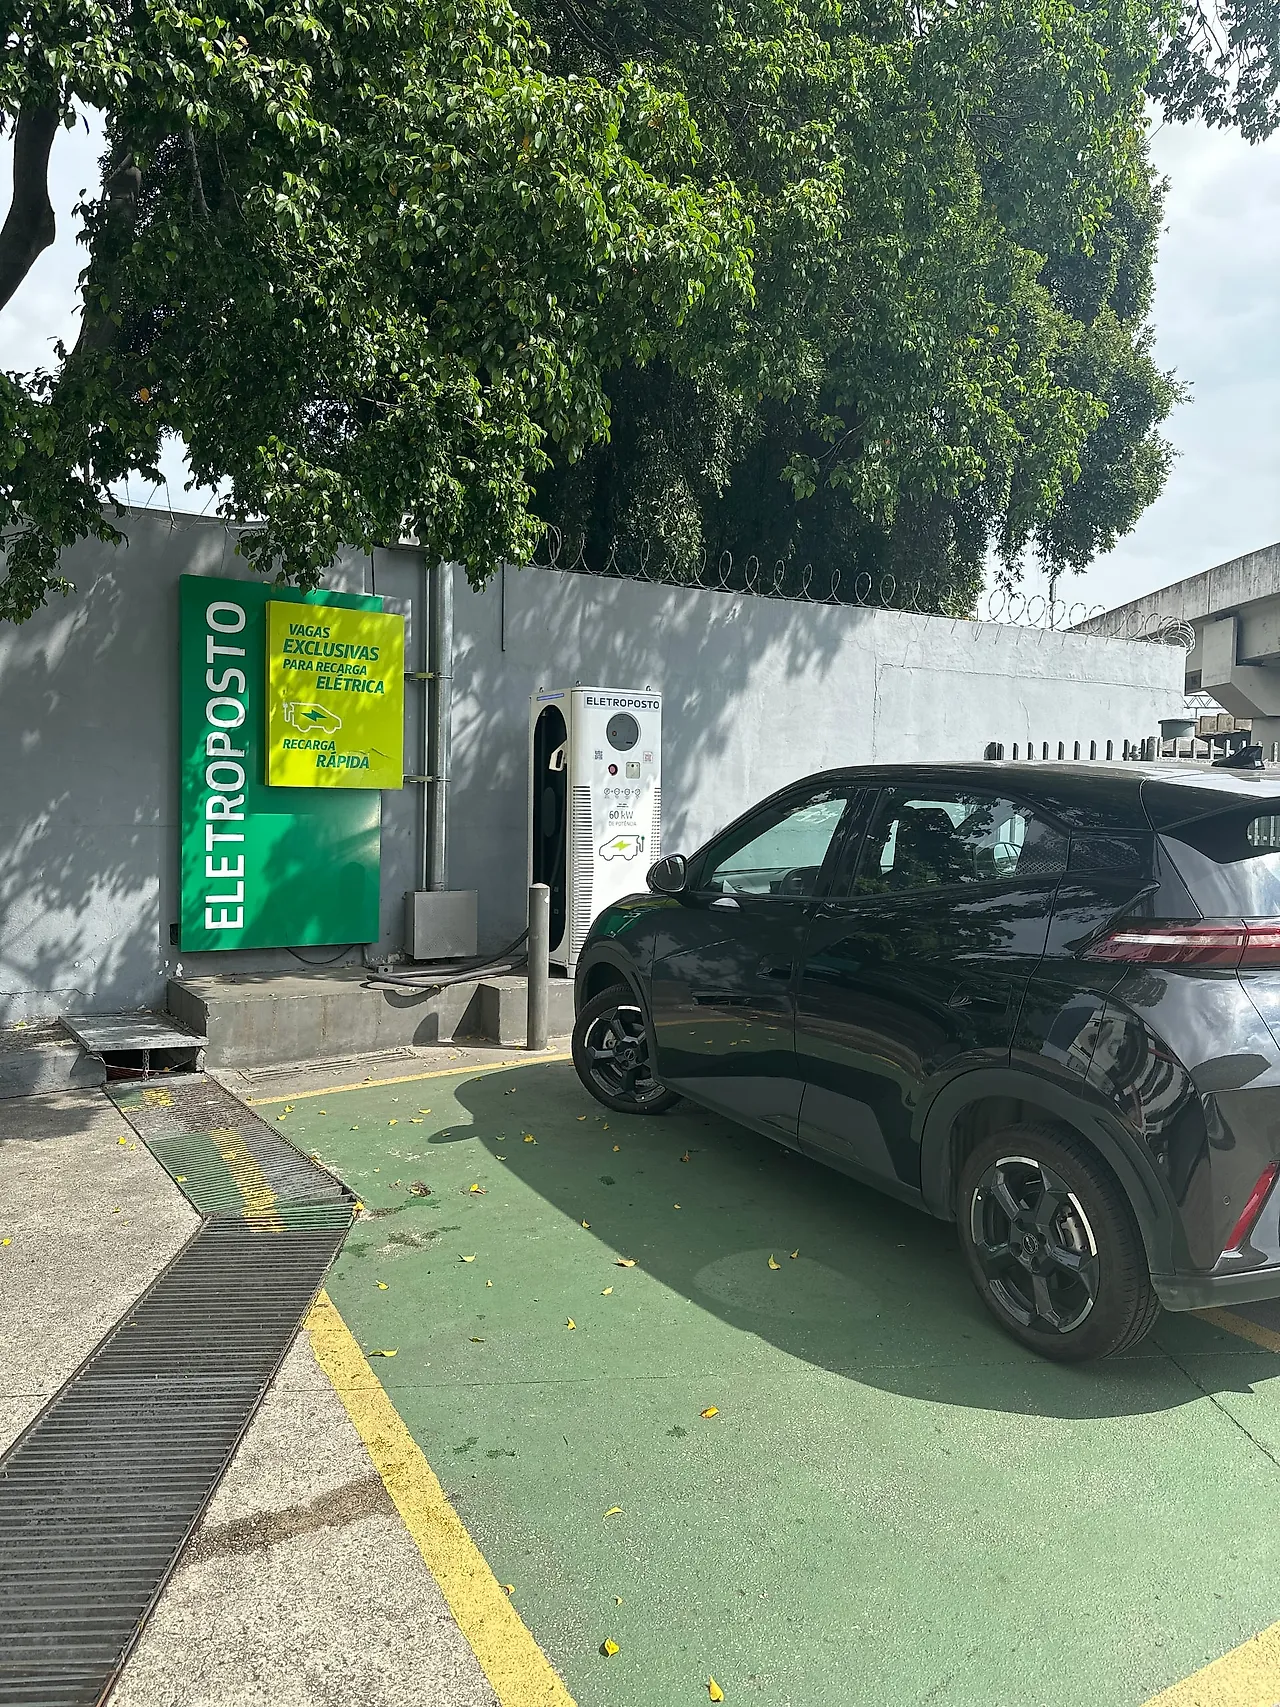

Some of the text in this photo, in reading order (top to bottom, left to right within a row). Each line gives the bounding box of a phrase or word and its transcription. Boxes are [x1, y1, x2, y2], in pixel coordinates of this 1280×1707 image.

[289, 623, 331, 638] VAGAS
[282, 638, 380, 661] EXCLUSIVAS
[282, 658, 367, 675] PARA RECARGA
[316, 674, 385, 694] ELÉTRICA
[586, 696, 660, 709] ELETROPOSTO
[282, 738, 336, 751] RECARGA
[204, 601, 247, 930] ELETROPOSTO
[316, 752, 369, 769] RÁPIDA
[608, 810, 634, 820] 60 kW
